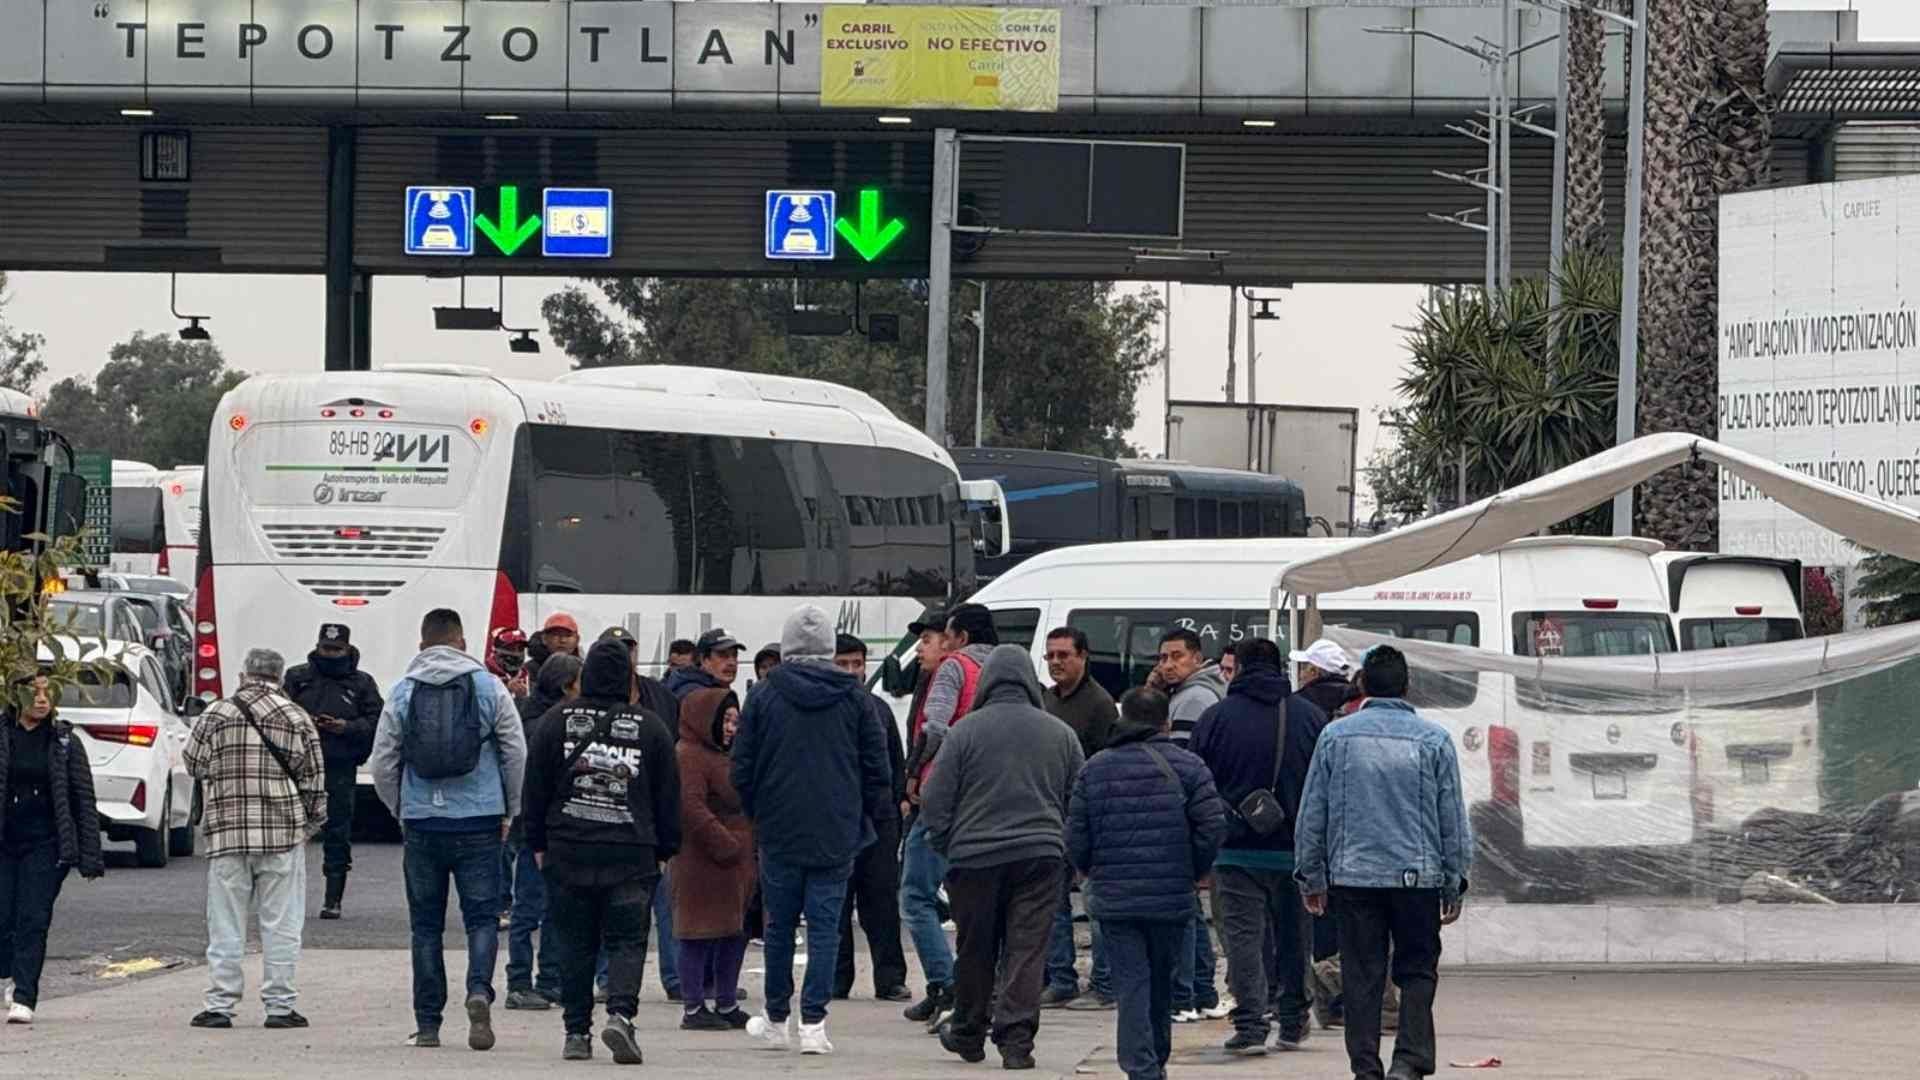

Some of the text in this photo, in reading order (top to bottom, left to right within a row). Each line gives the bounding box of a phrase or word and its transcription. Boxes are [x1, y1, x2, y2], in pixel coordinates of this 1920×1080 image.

[841, 23, 895, 34] CARRIL
[1005, 24, 1031, 33] CON
[1034, 25, 1056, 34] TAG
[826, 39, 909, 50] EXCLUSIVO
[927, 37, 1047, 53] NO EFECTIVO
[1843, 200, 1880, 219] CAPUFE
[1801, 317, 1809, 354] Y
[1810, 301, 1917, 354] MODERNIZACIÓN
[1719, 394, 1753, 430] PLAZA
[1755, 393, 1771, 429] DE
[1773, 389, 1814, 428] COBRO
[1816, 385, 1900, 425] TEPOTZOTLAN
[329, 431, 369, 456] 89-HB
[323, 473, 448, 486] Autotransportes Valle del Mezquital
[1819, 450, 1866, 495] MÉXICO
